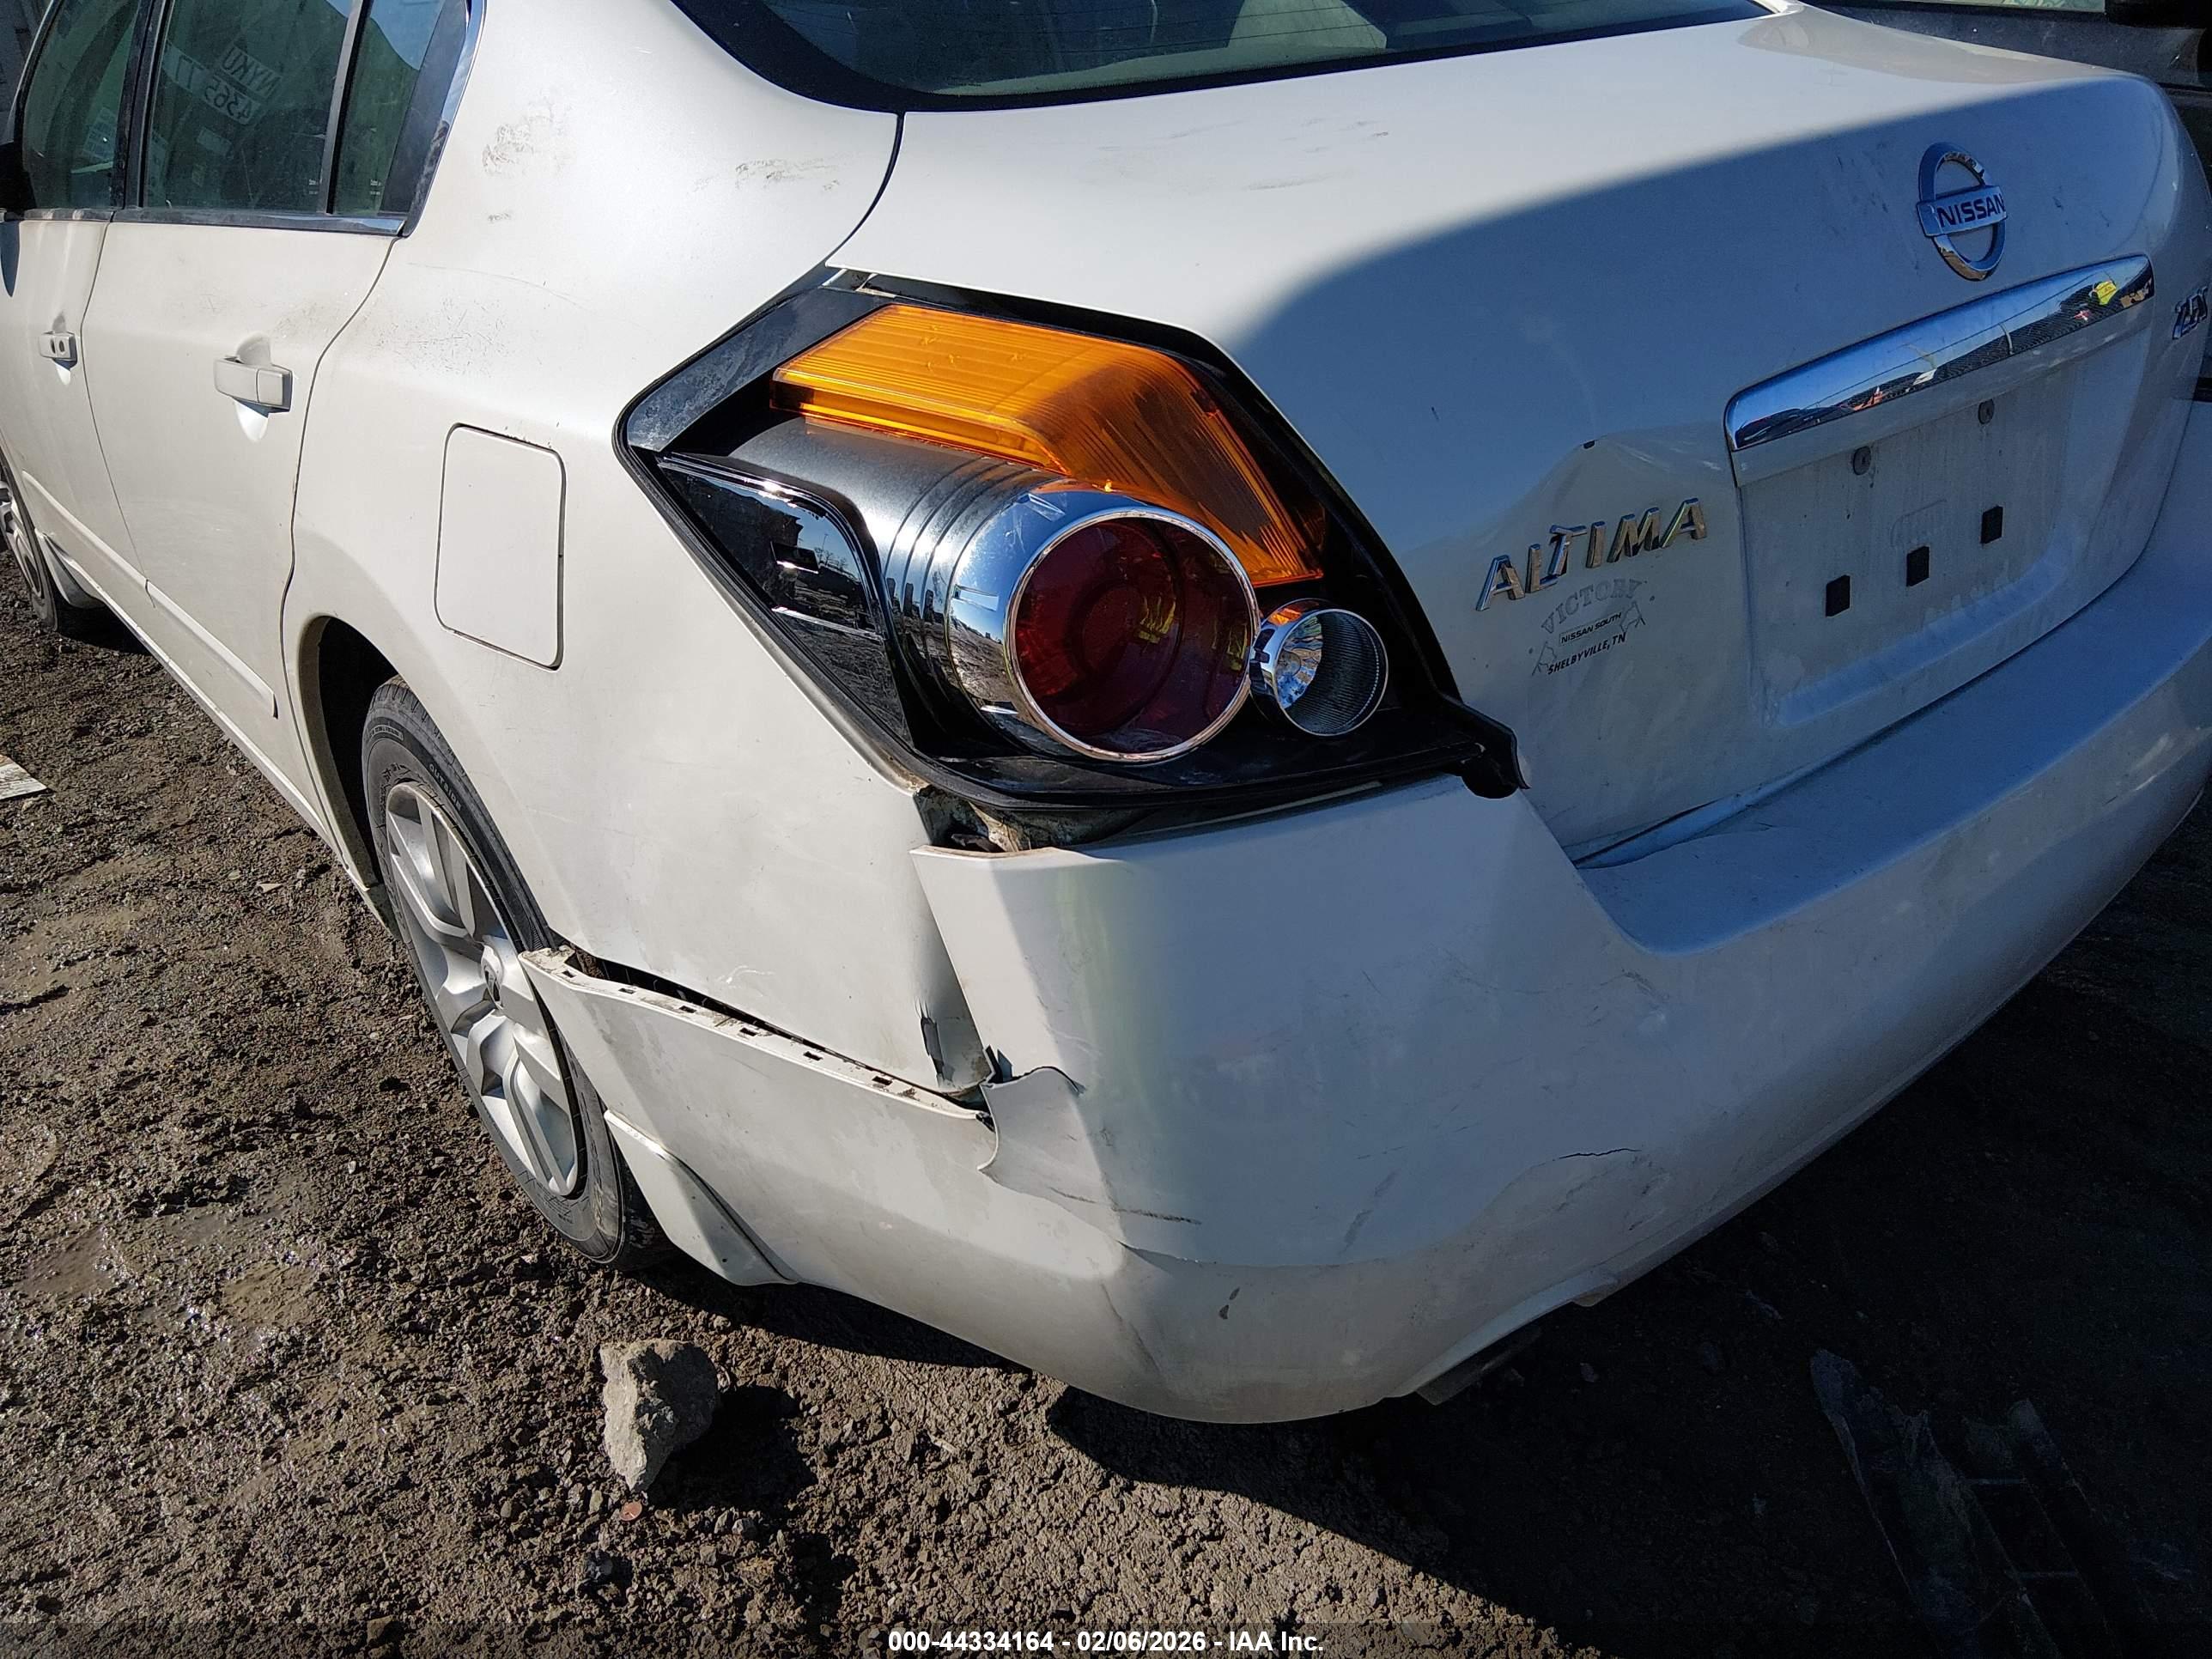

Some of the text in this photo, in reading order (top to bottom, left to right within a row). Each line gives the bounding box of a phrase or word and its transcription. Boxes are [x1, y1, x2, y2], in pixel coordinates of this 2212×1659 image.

[1936, 193, 2006, 228] NISSAN
[1475, 497, 1707, 611] ALTIMA
[1541, 577, 1643, 634] VICTORY
[1560, 611, 1622, 644] NISSAN SOUTH
[1547, 632, 1627, 675] SHELBYVILLE, TN
